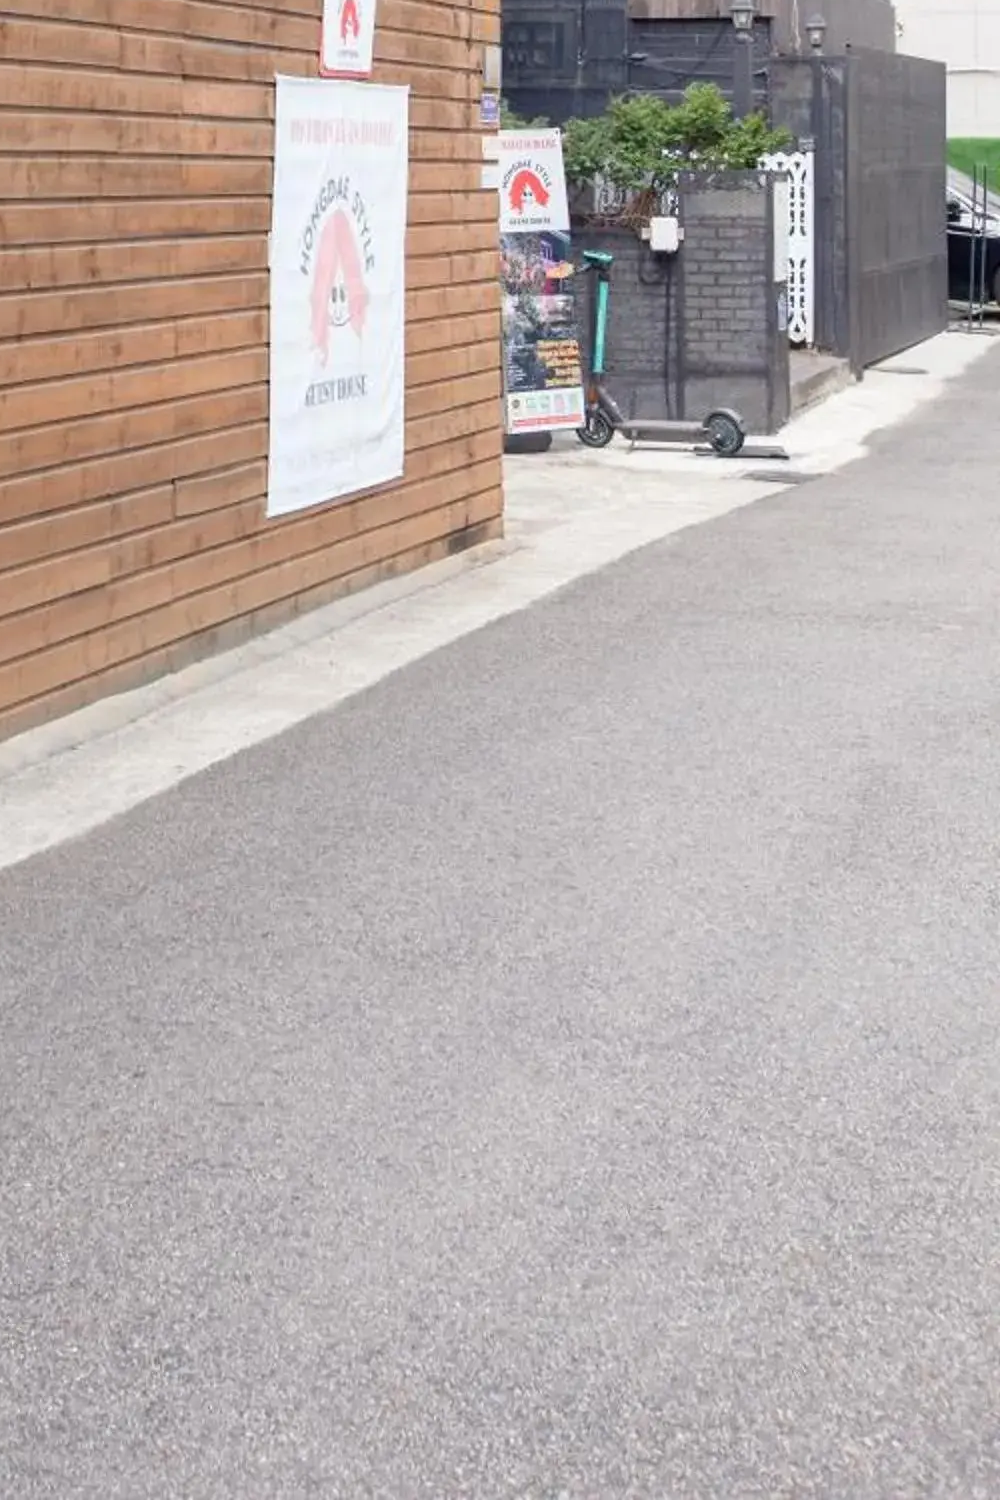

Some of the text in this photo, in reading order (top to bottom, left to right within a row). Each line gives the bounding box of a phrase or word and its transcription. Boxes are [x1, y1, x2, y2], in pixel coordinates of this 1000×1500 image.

[299, 175, 375, 277] HONGDAE STYLE
[304, 380, 336, 408] GUEST
